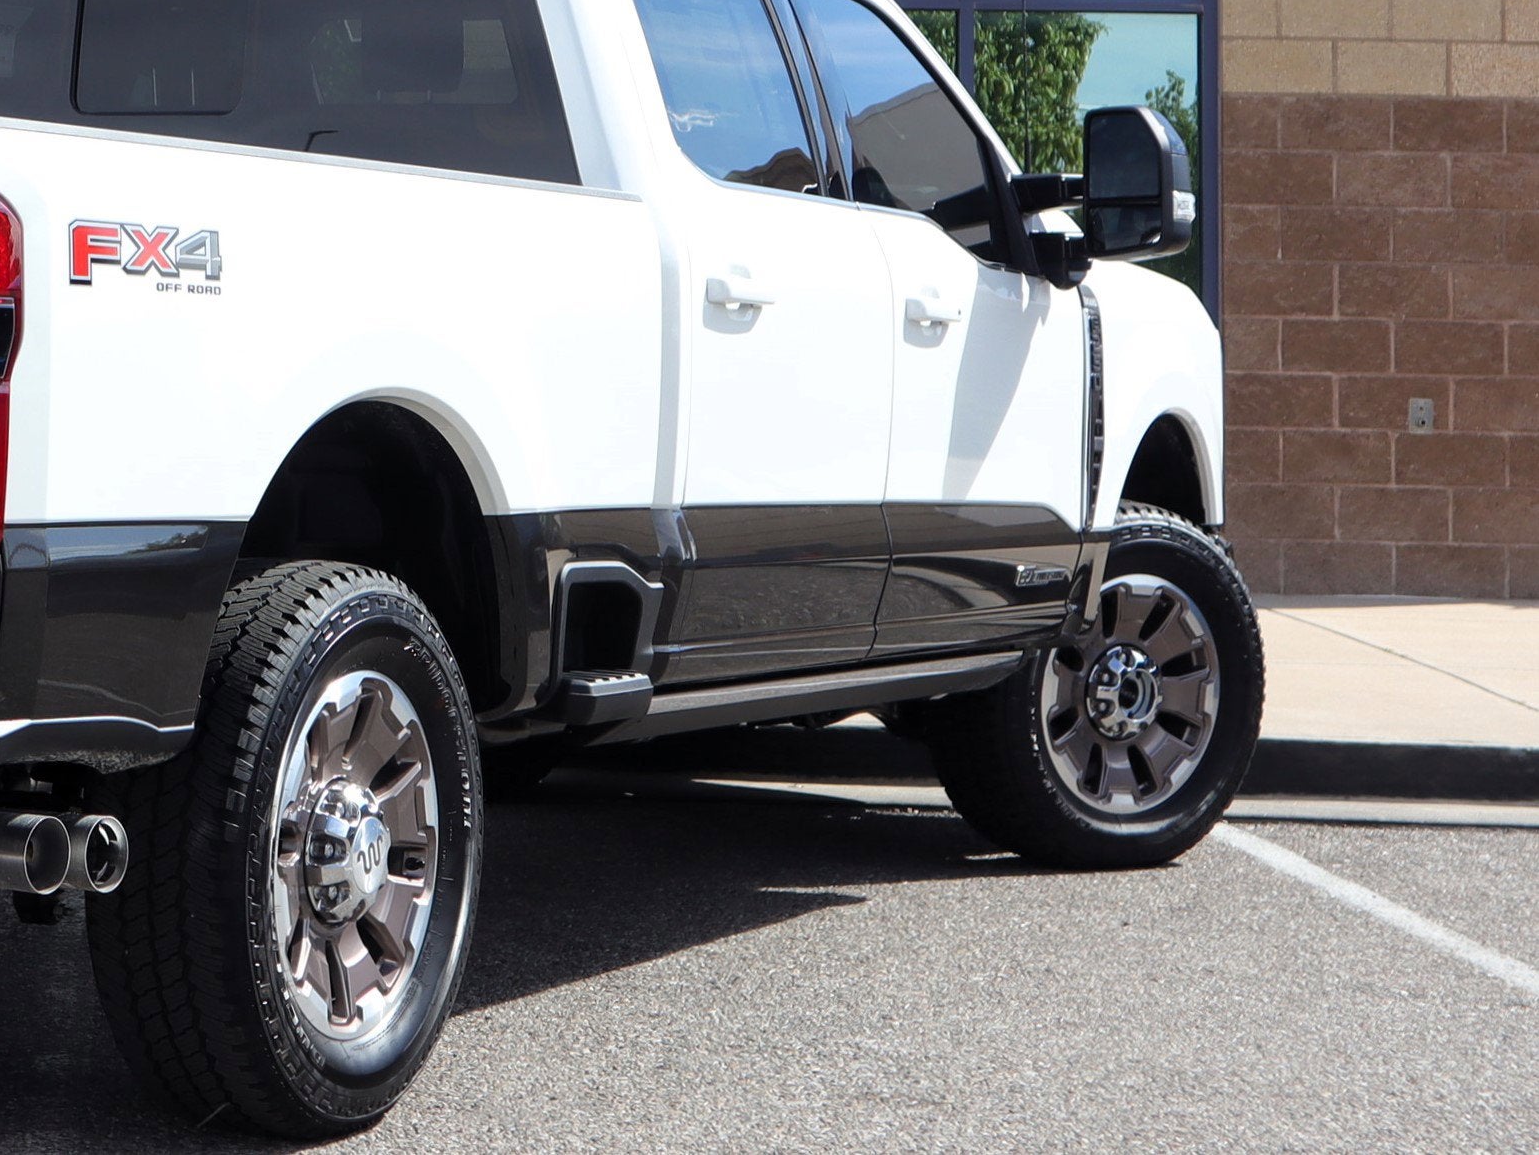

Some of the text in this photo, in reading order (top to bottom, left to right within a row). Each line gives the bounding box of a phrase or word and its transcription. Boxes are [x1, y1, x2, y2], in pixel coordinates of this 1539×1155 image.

[68, 218, 223, 286] FX4
[155, 282, 222, 296] OFF ROAD
